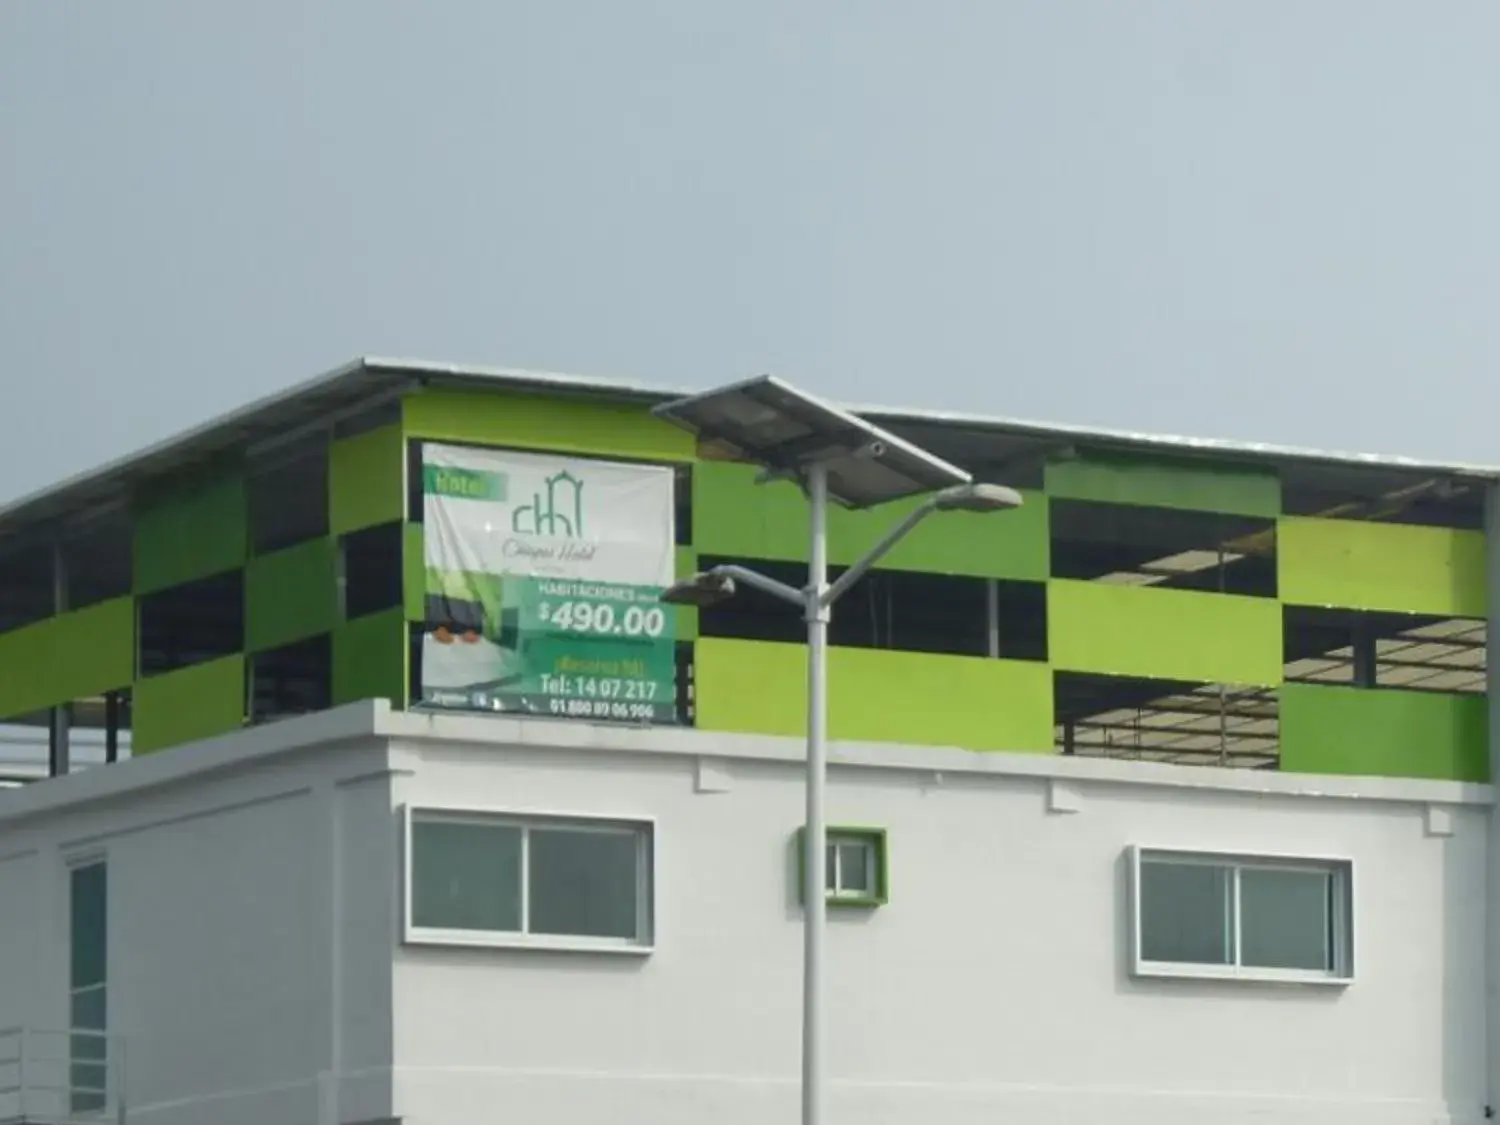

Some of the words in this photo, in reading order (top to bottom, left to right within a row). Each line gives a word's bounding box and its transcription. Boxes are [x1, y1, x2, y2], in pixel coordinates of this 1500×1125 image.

[540, 673, 571, 695] Tel:
[576, 676, 596, 697] 14
[601, 678, 621, 698] 07
[624, 680, 657, 700] 217
